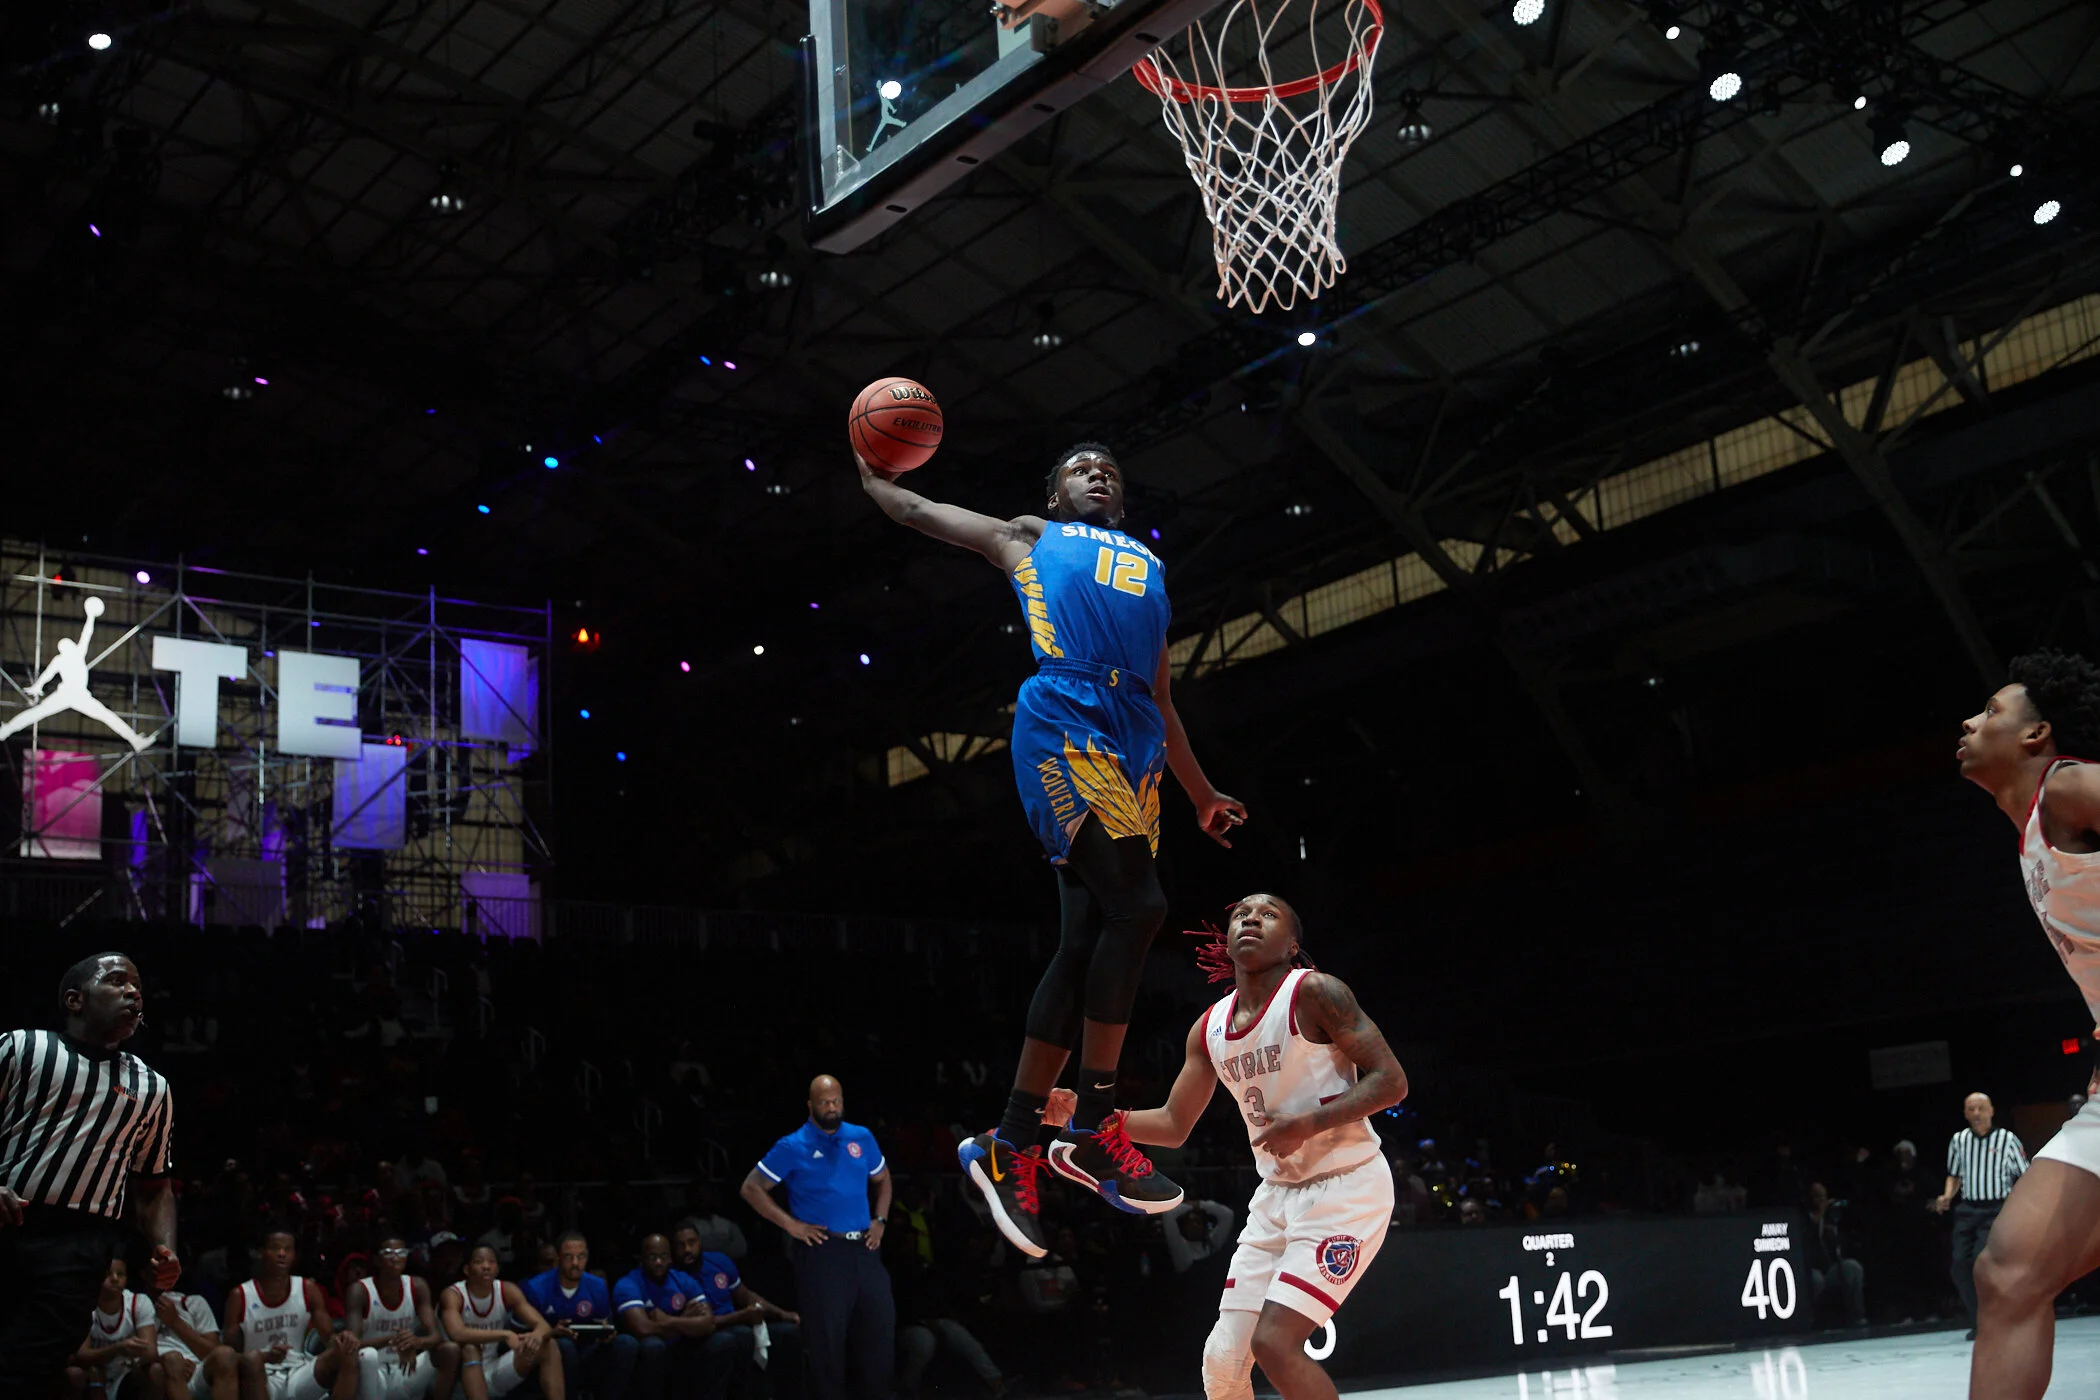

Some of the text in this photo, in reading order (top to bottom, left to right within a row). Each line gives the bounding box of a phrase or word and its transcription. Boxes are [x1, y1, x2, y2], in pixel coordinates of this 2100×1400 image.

[888, 386, 937, 405] Wilso
[1095, 546, 1148, 597] 12
[1109, 669, 1119, 687] S
[1244, 1086, 1268, 1127] 3
[1522, 1233, 1575, 1251] QUARTER
[1545, 1251, 1556, 1267] 2
[1741, 1257, 1796, 1320] 40
[1498, 1269, 1613, 1345] 1:42
